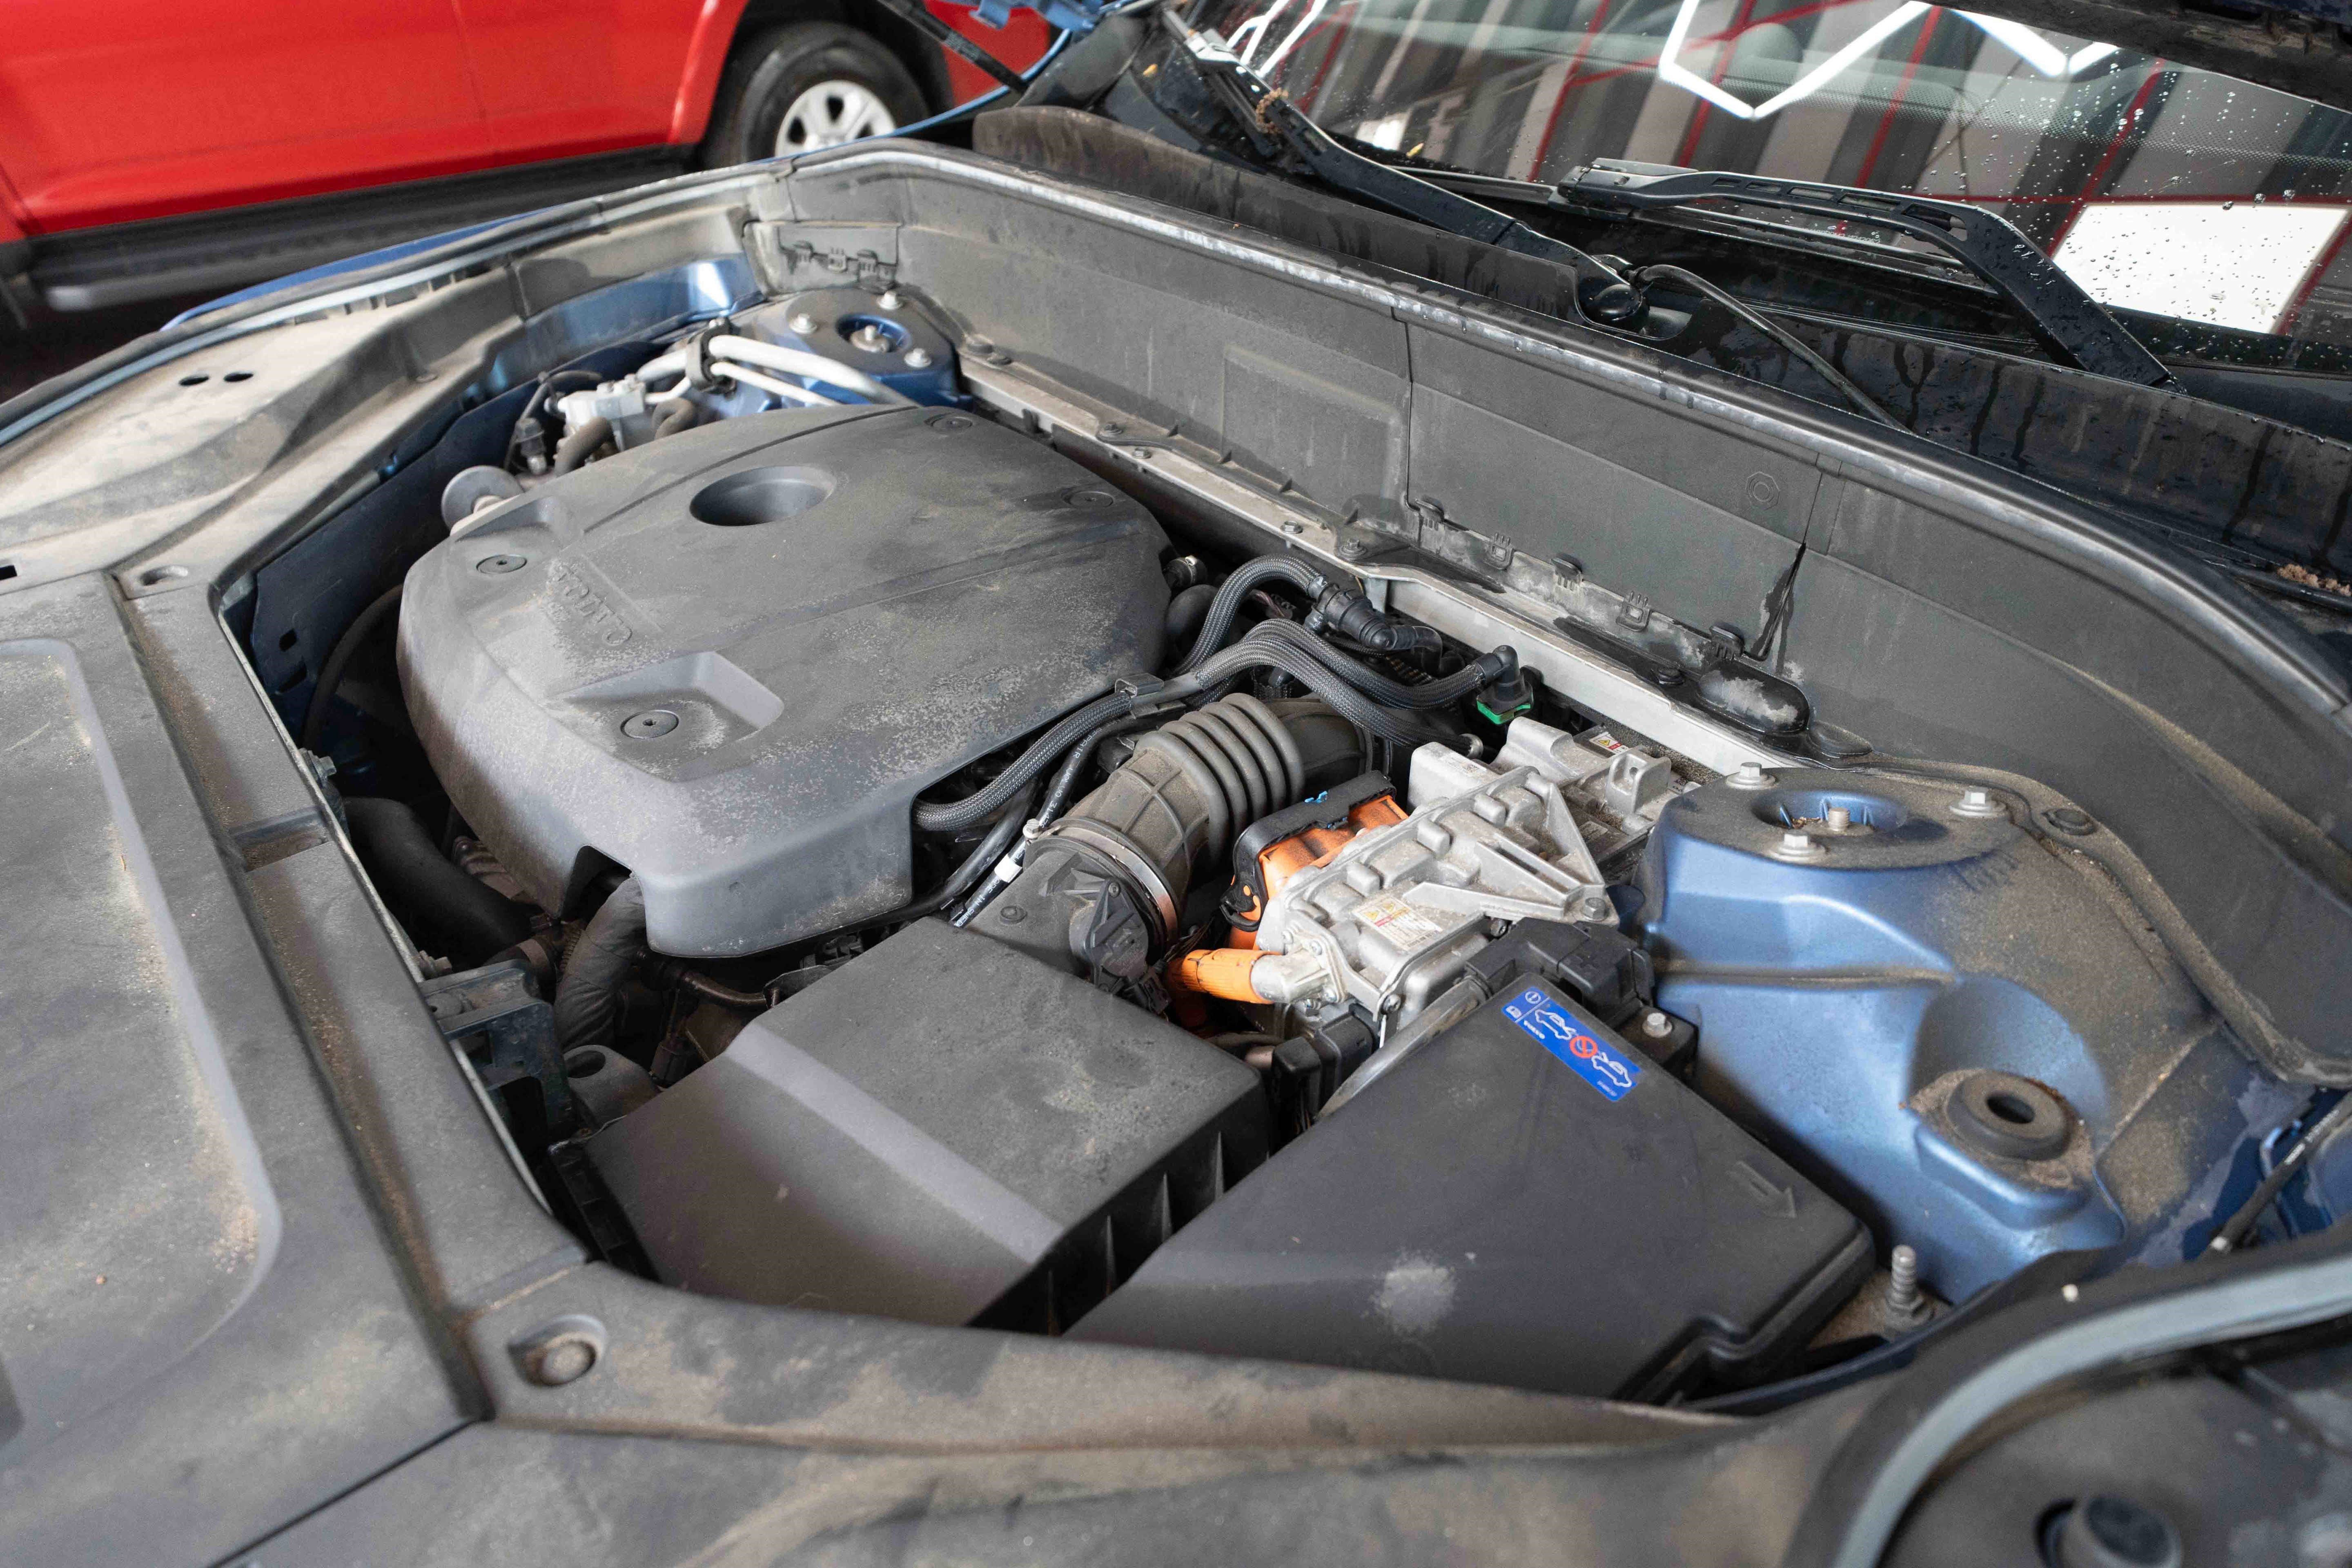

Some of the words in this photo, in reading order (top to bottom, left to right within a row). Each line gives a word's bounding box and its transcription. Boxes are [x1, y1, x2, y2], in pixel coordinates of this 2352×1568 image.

[1055, 768, 1073, 797] VOLVO
[987, 878, 1002, 893] ADE
[975, 895, 985, 906] IN
